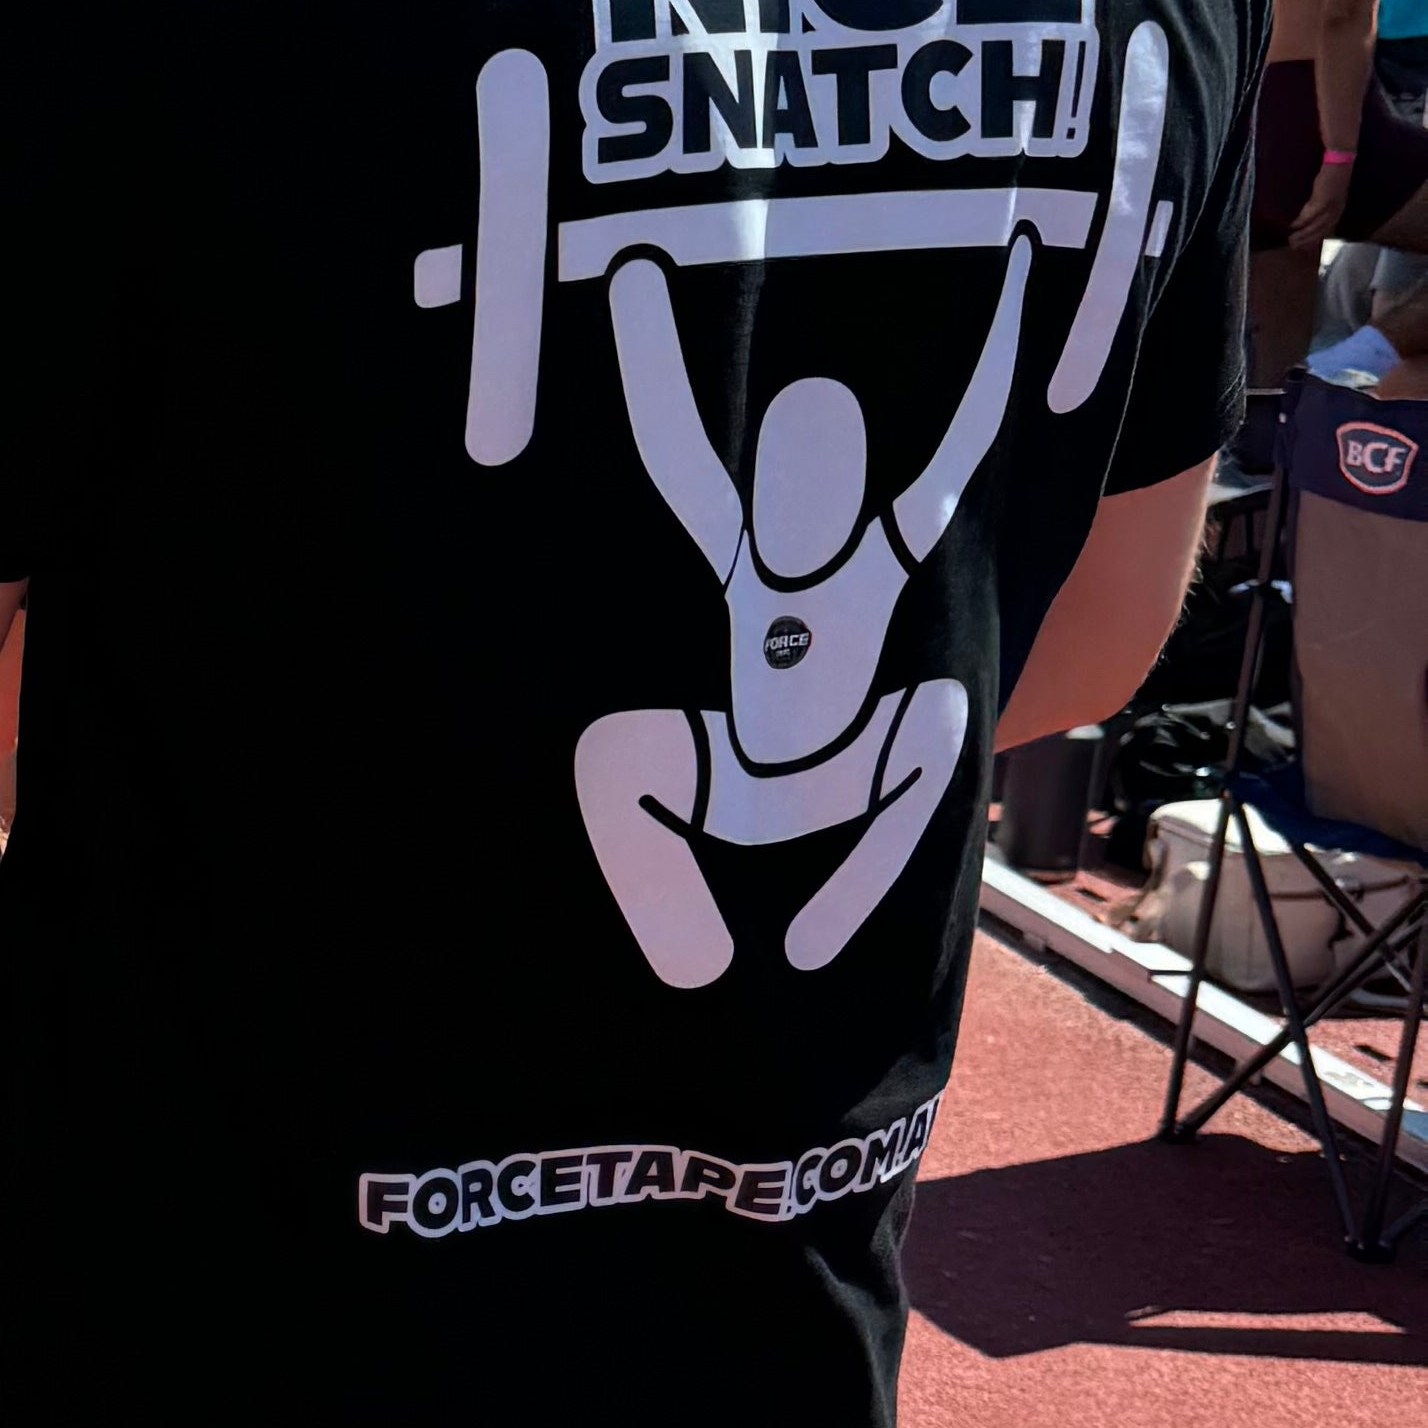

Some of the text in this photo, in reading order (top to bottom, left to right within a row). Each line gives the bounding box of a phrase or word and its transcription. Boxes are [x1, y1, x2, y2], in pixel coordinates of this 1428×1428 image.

[579, 39, 1100, 184] SNATCH!
[1346, 439, 1408, 474] BCF
[765, 632, 810, 652] FORCE
[360, 1089, 944, 1238] FORCETAPE.COM.A
